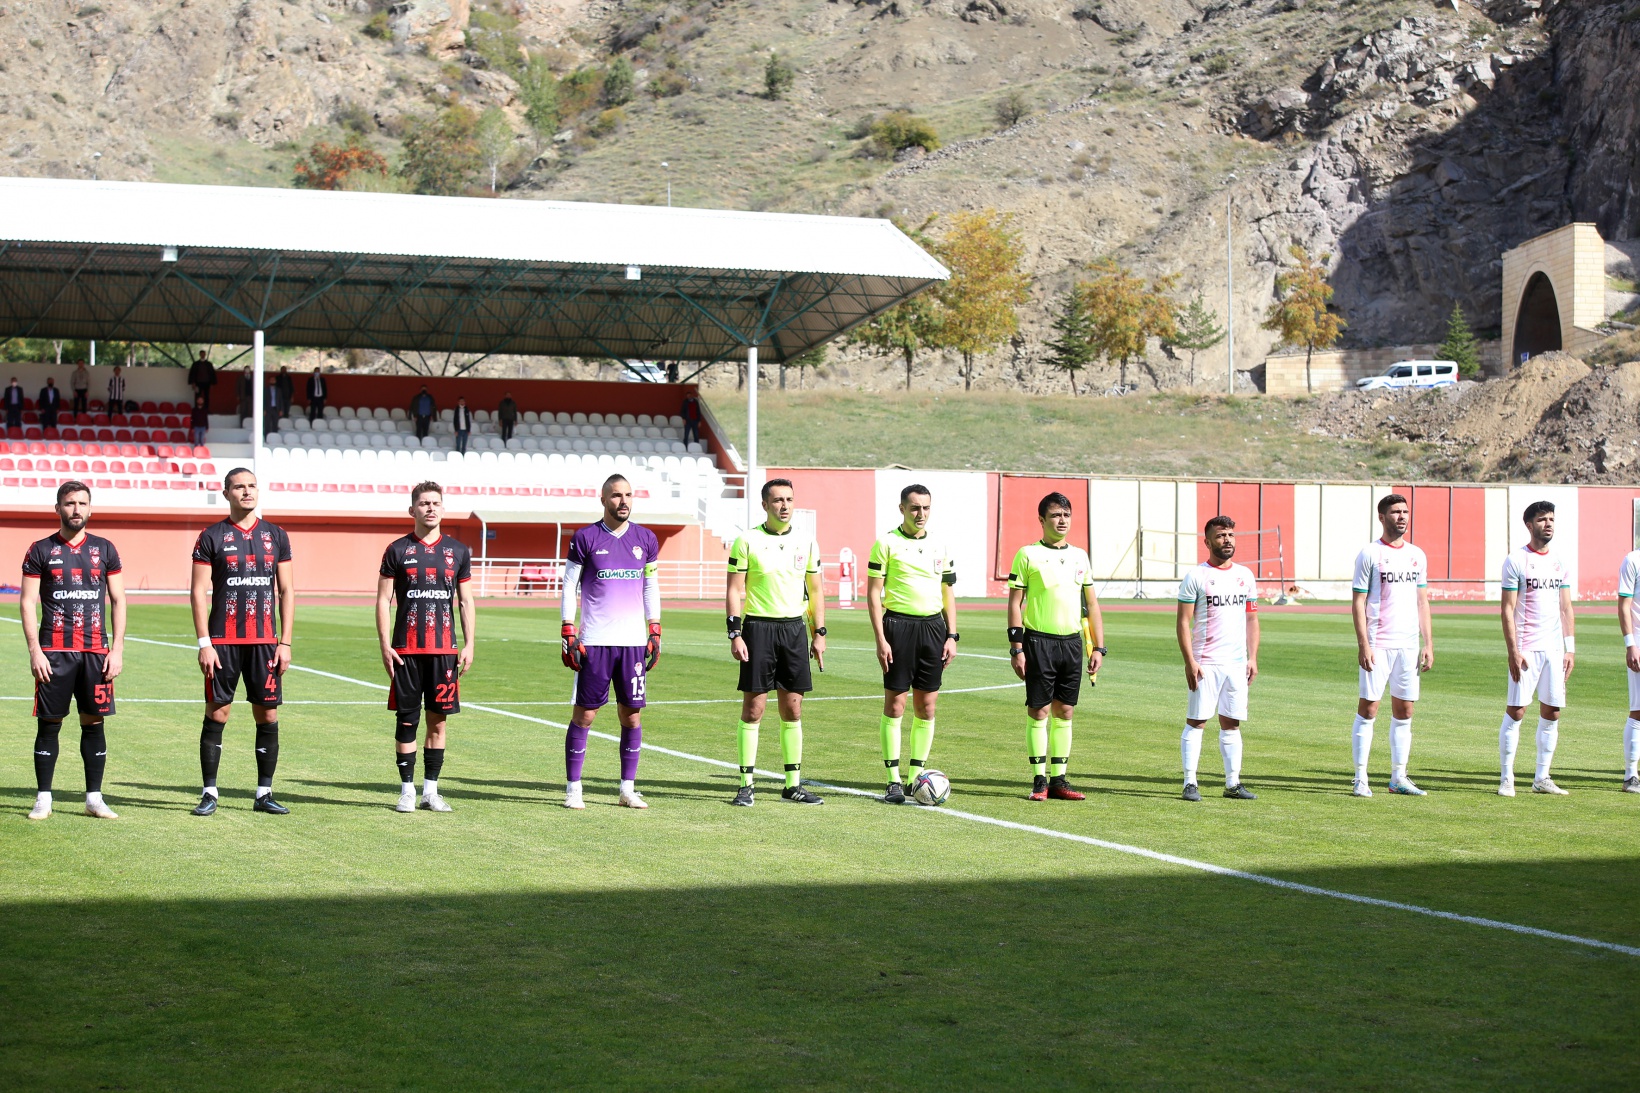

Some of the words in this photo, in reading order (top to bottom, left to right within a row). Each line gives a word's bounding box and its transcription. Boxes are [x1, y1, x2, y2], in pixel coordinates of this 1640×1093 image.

[264, 674, 277, 693] 4
[435, 683, 456, 702] 22
[631, 676, 645, 695] 13
